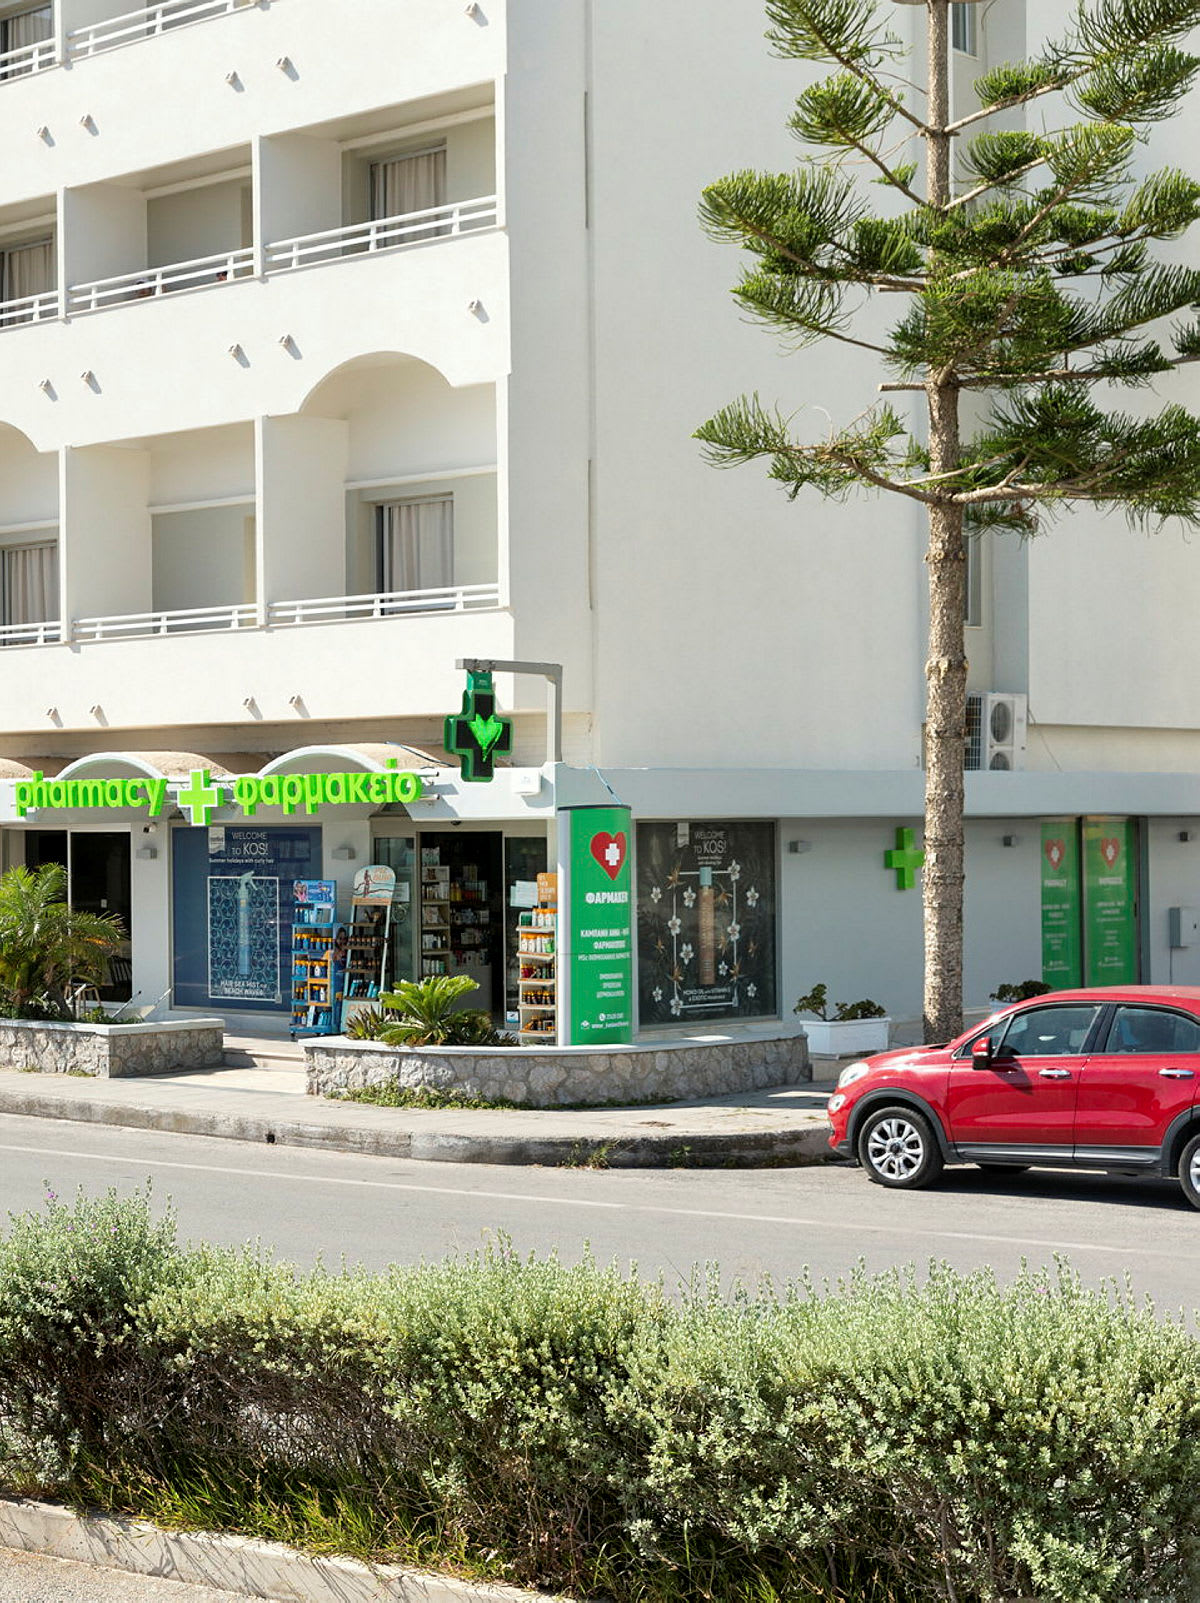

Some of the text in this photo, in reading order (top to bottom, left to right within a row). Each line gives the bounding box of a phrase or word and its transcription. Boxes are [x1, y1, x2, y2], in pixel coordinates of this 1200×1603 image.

[15, 770, 168, 817] pharmacy
[231, 831, 268, 840] WELCOME
[231, 842, 269, 856] TO KOS!
[703, 839, 727, 854] KOS!
